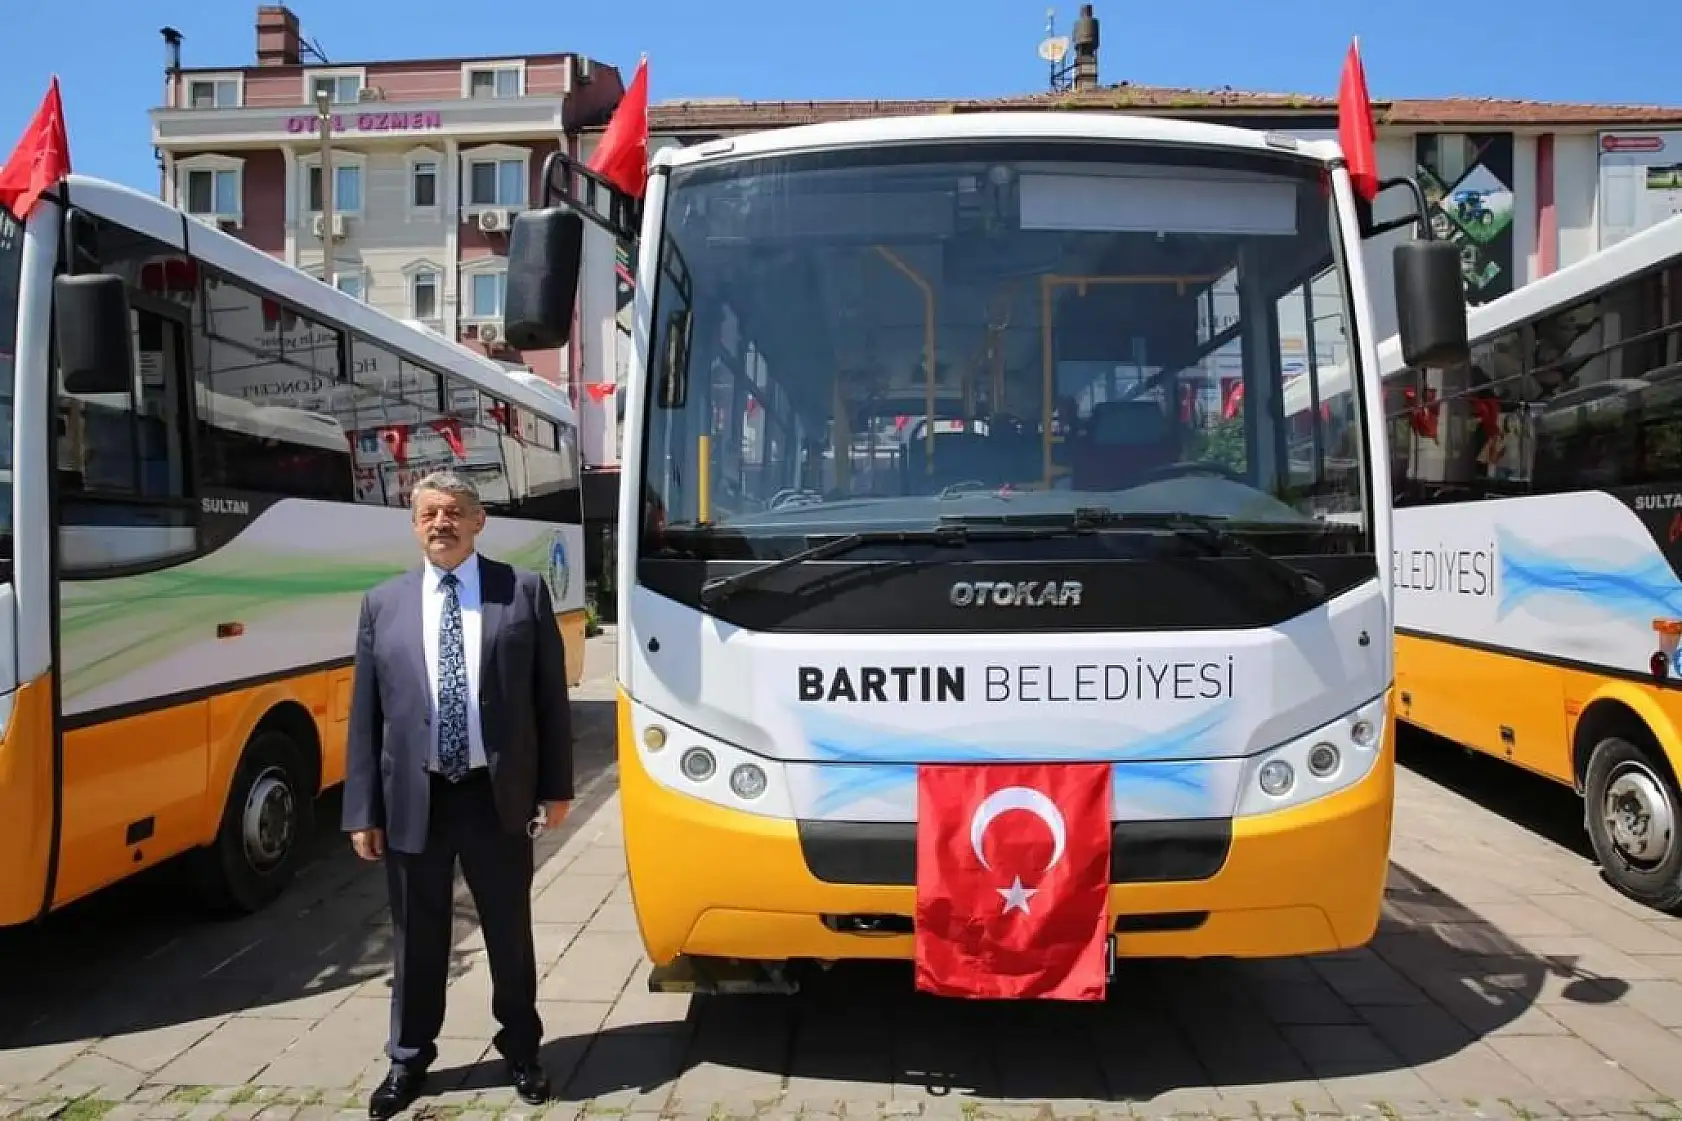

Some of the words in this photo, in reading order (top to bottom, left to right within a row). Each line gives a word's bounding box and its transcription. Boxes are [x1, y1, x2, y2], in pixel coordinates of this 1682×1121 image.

[287, 114, 346, 134] OTL
[202, 497, 249, 516] SULTAN
[950, 581, 1083, 606] OTOKAR
[797, 666, 966, 702] BARTIN
[985, 655, 1234, 702] BELEDİYESİ
